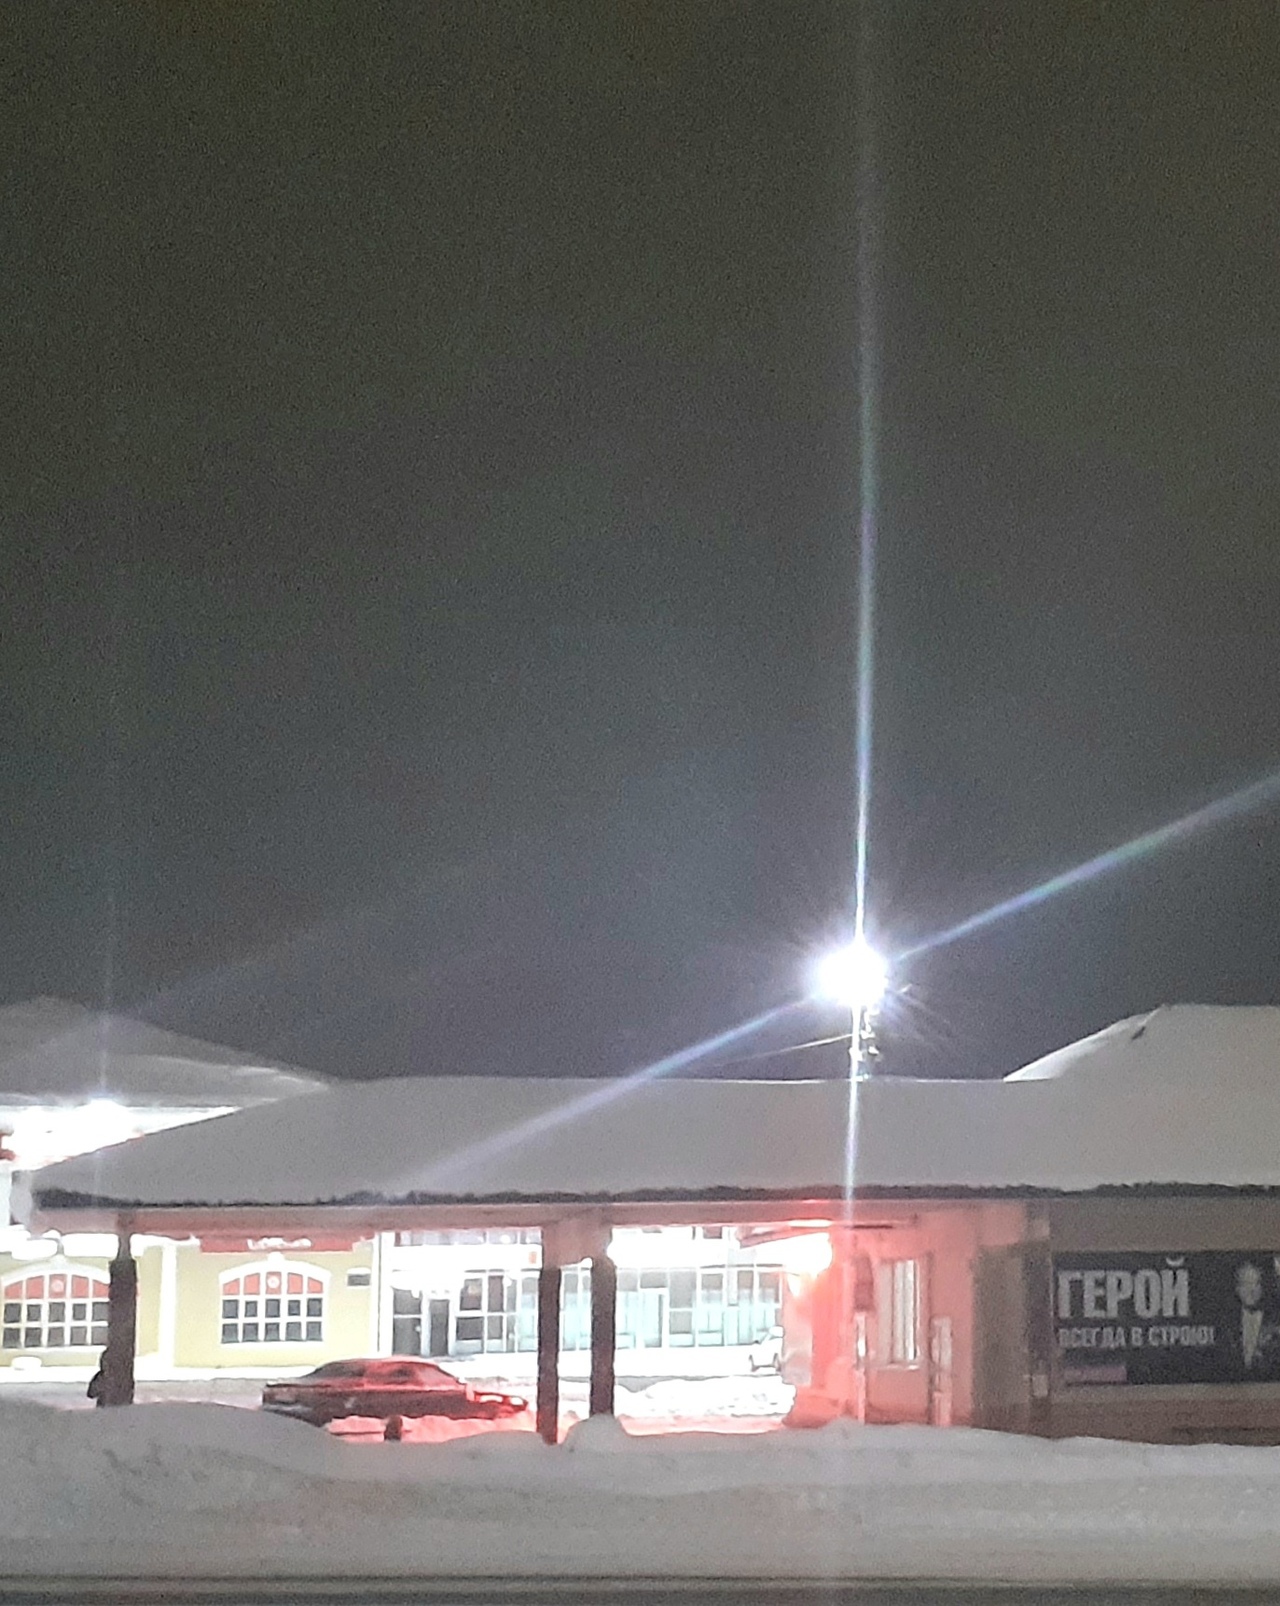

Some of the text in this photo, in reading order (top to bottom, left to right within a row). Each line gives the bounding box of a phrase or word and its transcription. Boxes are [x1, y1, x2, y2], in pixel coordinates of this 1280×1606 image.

[1058, 1257, 1189, 1318] ГЕРОЙ
[1058, 1327, 1127, 1347] ВСЕГДА
[1131, 1326, 1143, 1346] В
